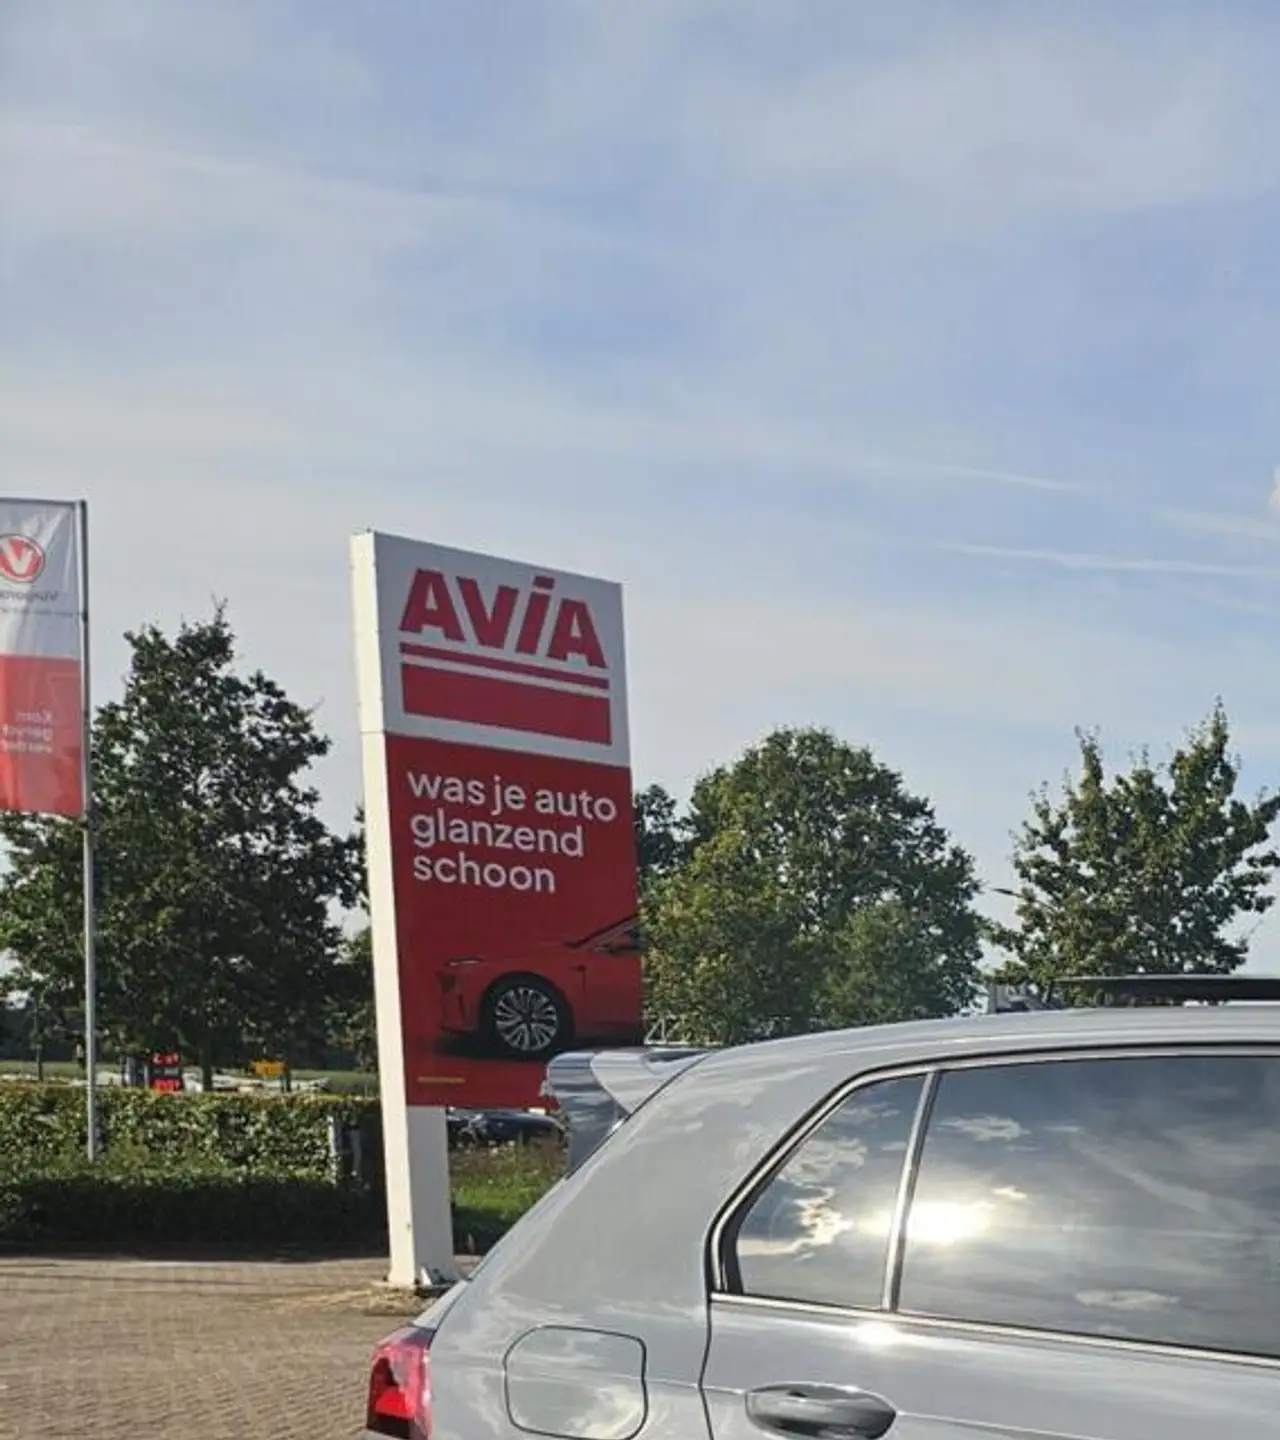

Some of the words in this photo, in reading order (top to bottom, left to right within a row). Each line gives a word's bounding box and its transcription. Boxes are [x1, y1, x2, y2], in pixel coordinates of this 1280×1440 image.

[407, 771, 485, 805] was
[491, 775, 526, 816] je
[535, 789, 617, 822] auto
[411, 807, 584, 858] glanzend
[413, 851, 556, 893] schoon
